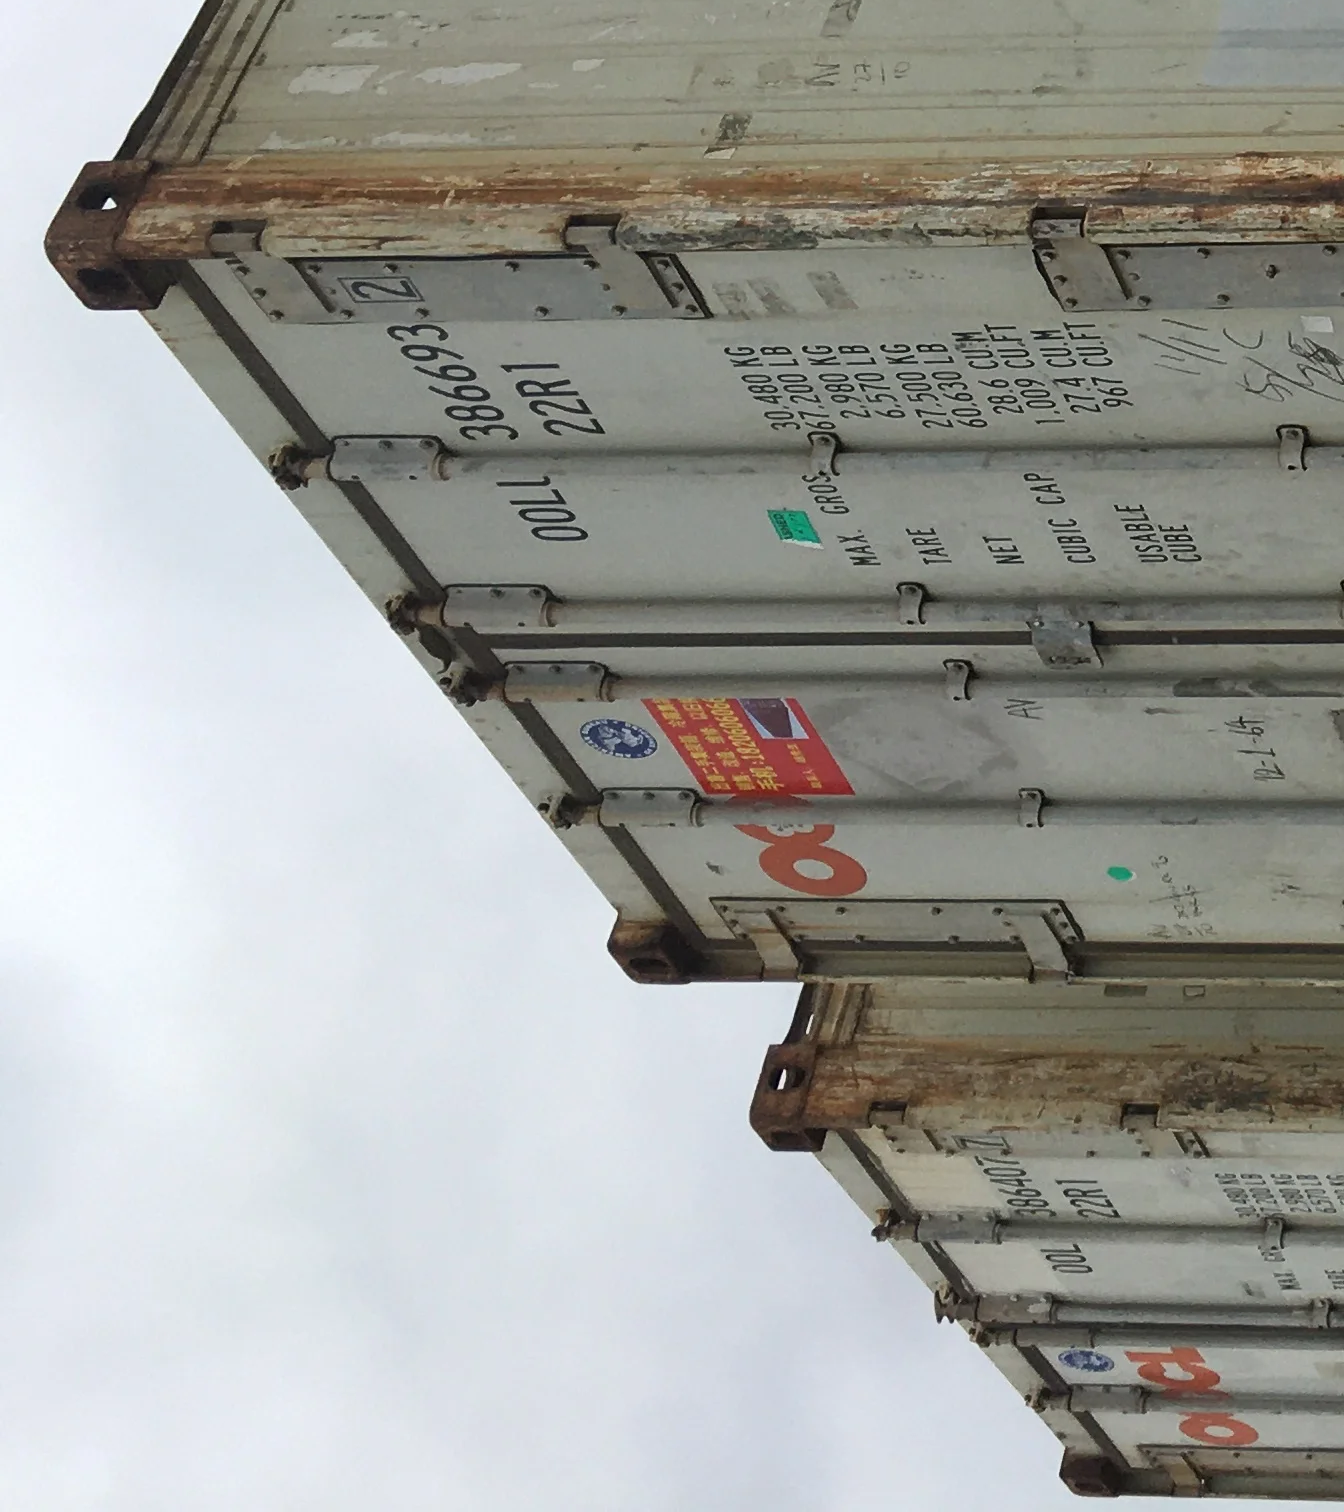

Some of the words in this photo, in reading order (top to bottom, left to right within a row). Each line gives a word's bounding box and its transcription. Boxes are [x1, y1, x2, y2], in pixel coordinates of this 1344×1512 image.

[350, 279, 418, 300] 2
[723, 346, 763, 367] KG
[760, 346, 800, 367] LB
[802, 345, 842, 366] KG
[837, 344, 877, 365] LB
[880, 344, 919, 365] KG
[916, 343, 955, 364] LB
[386, 324, 519, 440] 386693
[977, 379, 1025, 414] 28.6
[1052, 377, 1102, 413] 27.4
[1091, 377, 1134, 408] 967
[500, 364, 605, 436] 22R1
[801, 474, 850, 515] GROS
[1023, 472, 1066, 505] CAP
[837, 529, 881, 566] MAX.
[905, 528, 952, 565] TARE
[1047, 518, 1097, 563] CUBIC
[1113, 504, 1169, 563] USABLE
[1157, 524, 1203, 562] CUBE
[982, 535, 1025, 564] NET
[974, 1156, 1057, 1217] 386407
[1214, 1173, 1240, 1185] KG
[1240, 1173, 1266, 1185] LB
[1270, 1173, 1296, 1185] KG
[1296, 1174, 1322, 1186] LB
[1055, 1179, 1121, 1218] 22R1
[1040, 1244, 1093, 1274] OOL
